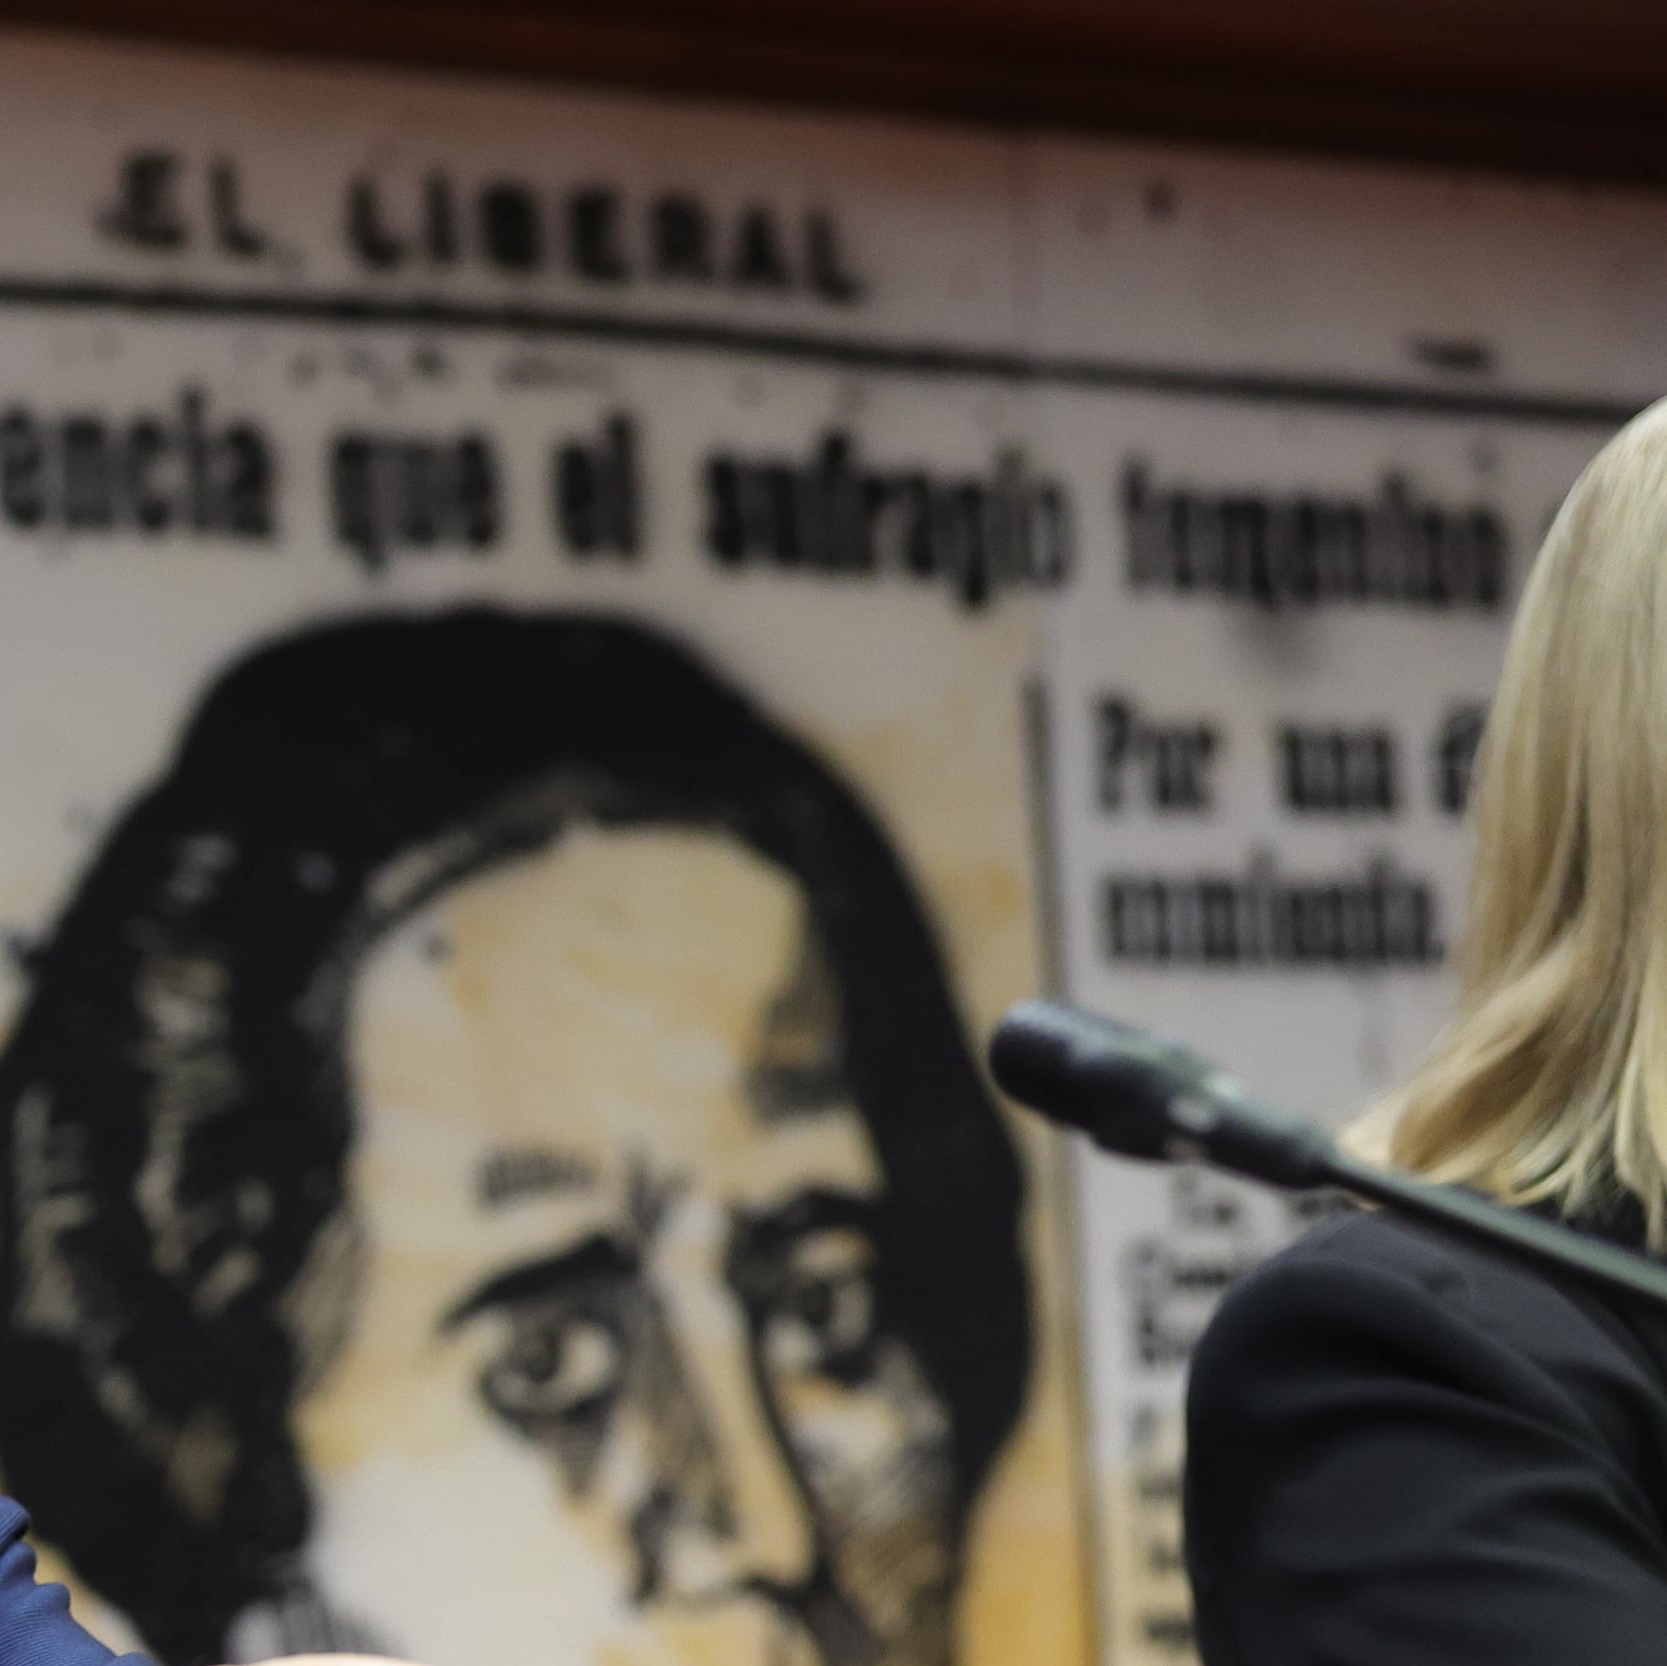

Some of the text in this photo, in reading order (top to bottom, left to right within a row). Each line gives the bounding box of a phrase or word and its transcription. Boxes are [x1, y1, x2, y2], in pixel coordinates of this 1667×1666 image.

[107, 146, 870, 306] EL LIBERAL
[329, 428, 503, 575] que
[555, 408, 641, 562] el
[705, 430, 1073, 612] sufragio
